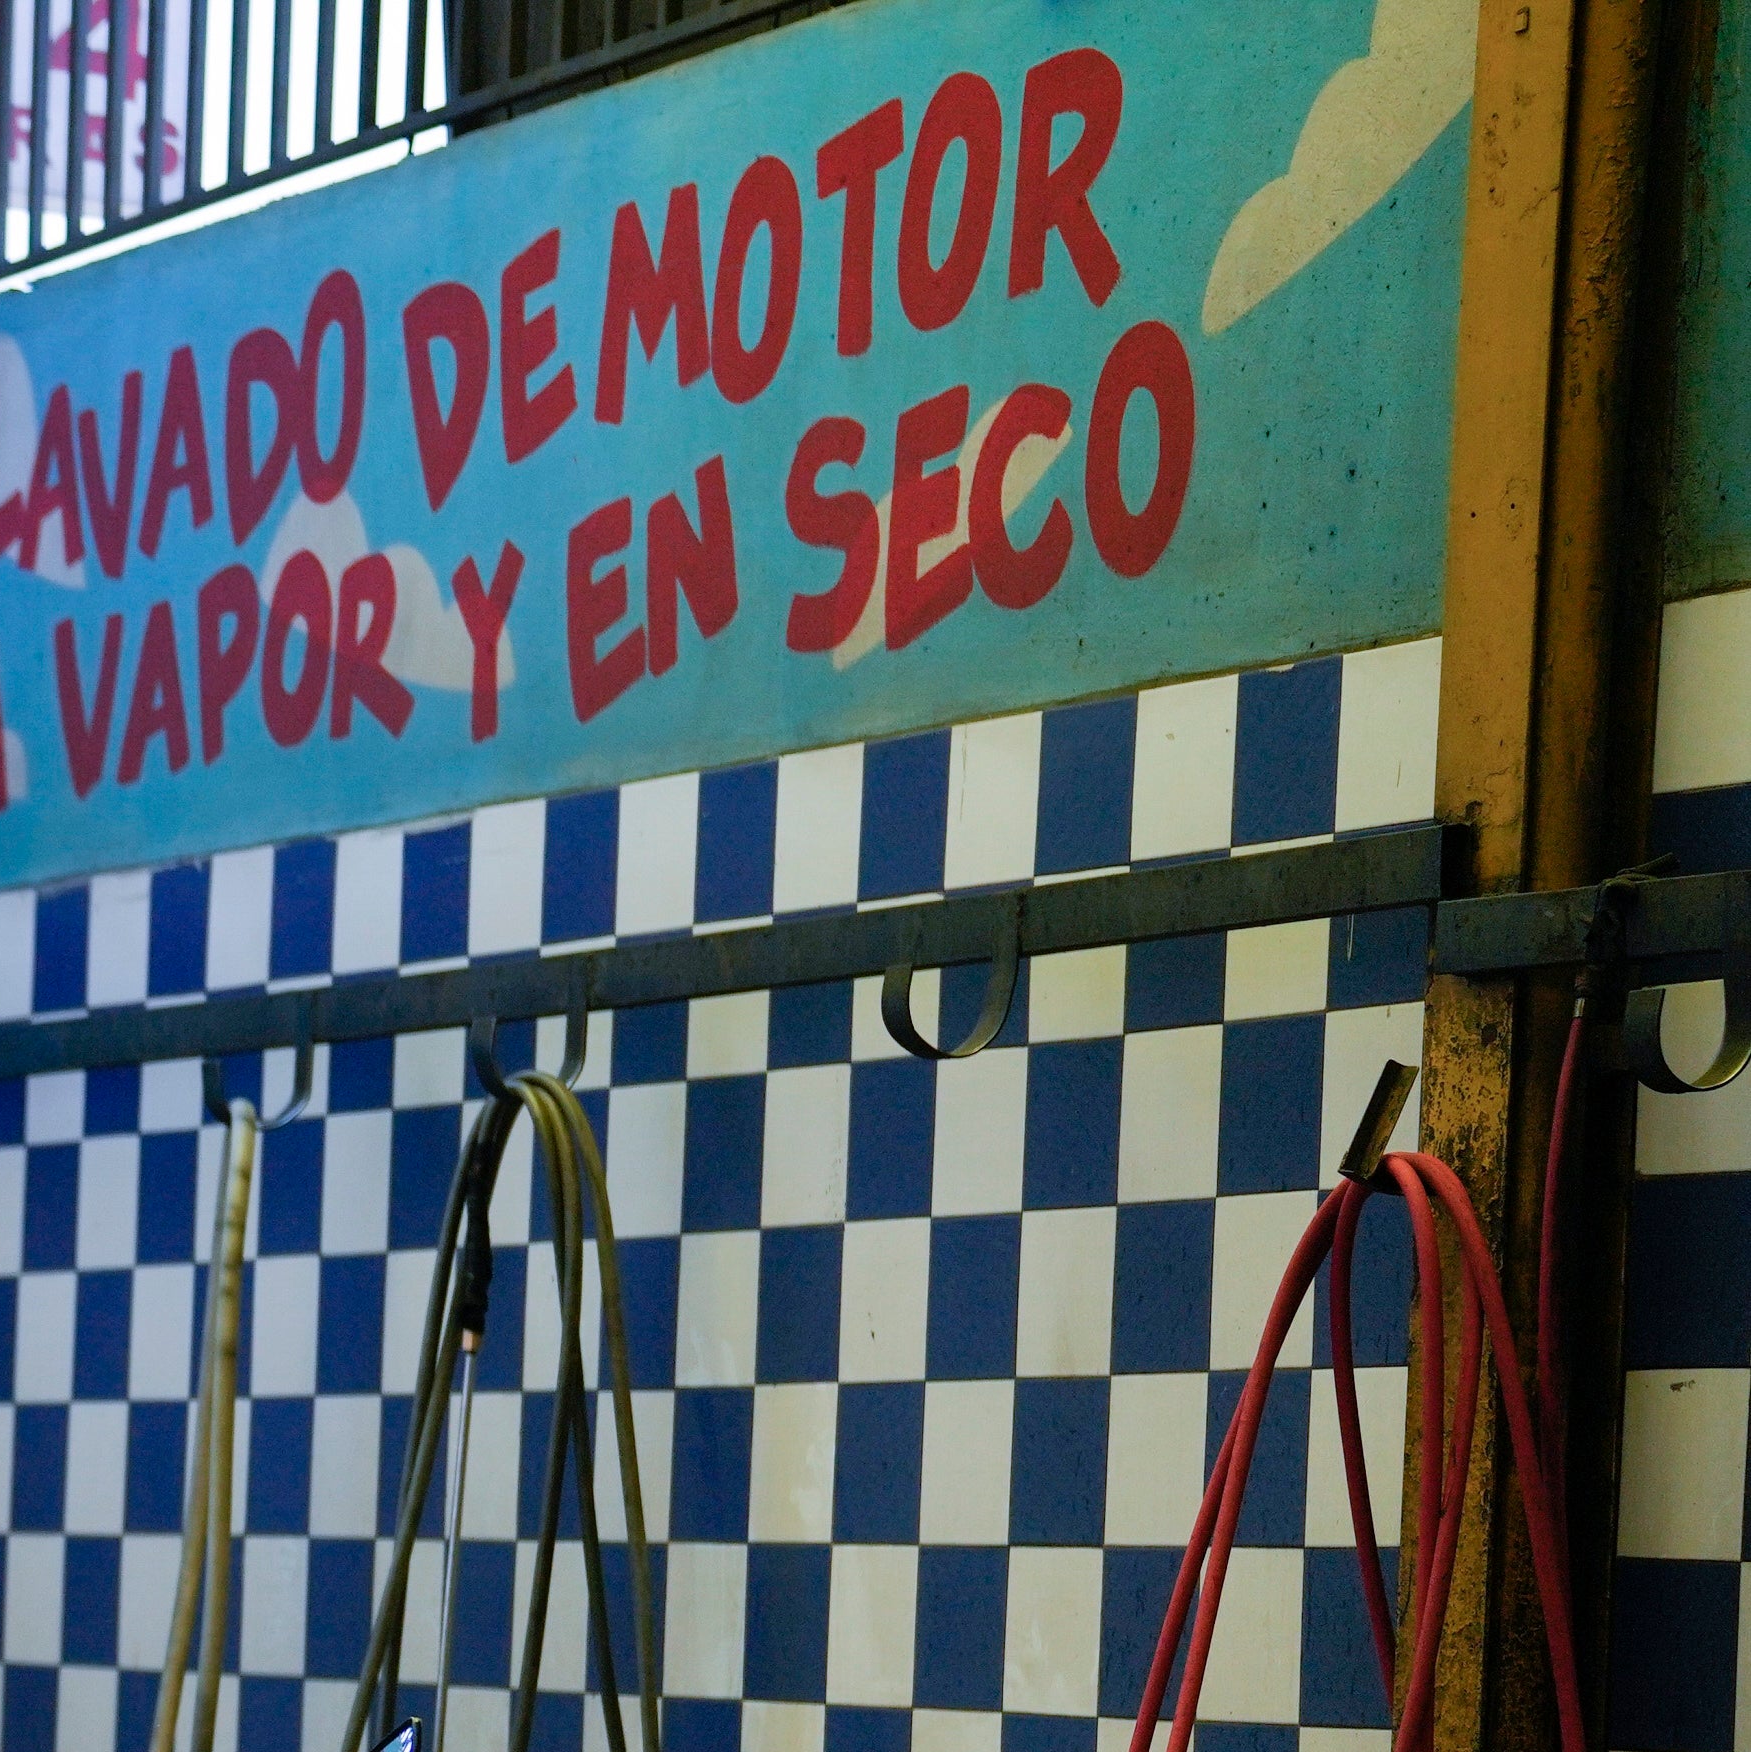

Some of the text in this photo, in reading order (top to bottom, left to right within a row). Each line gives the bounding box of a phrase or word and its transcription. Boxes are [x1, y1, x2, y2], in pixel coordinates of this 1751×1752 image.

[401, 226, 577, 512] DE
[593, 46, 1124, 427] MOTOR
[50, 546, 415, 804] VAPOR
[450, 538, 524, 743] Y
[566, 454, 740, 727] EN
[784, 318, 1198, 656] SECO
